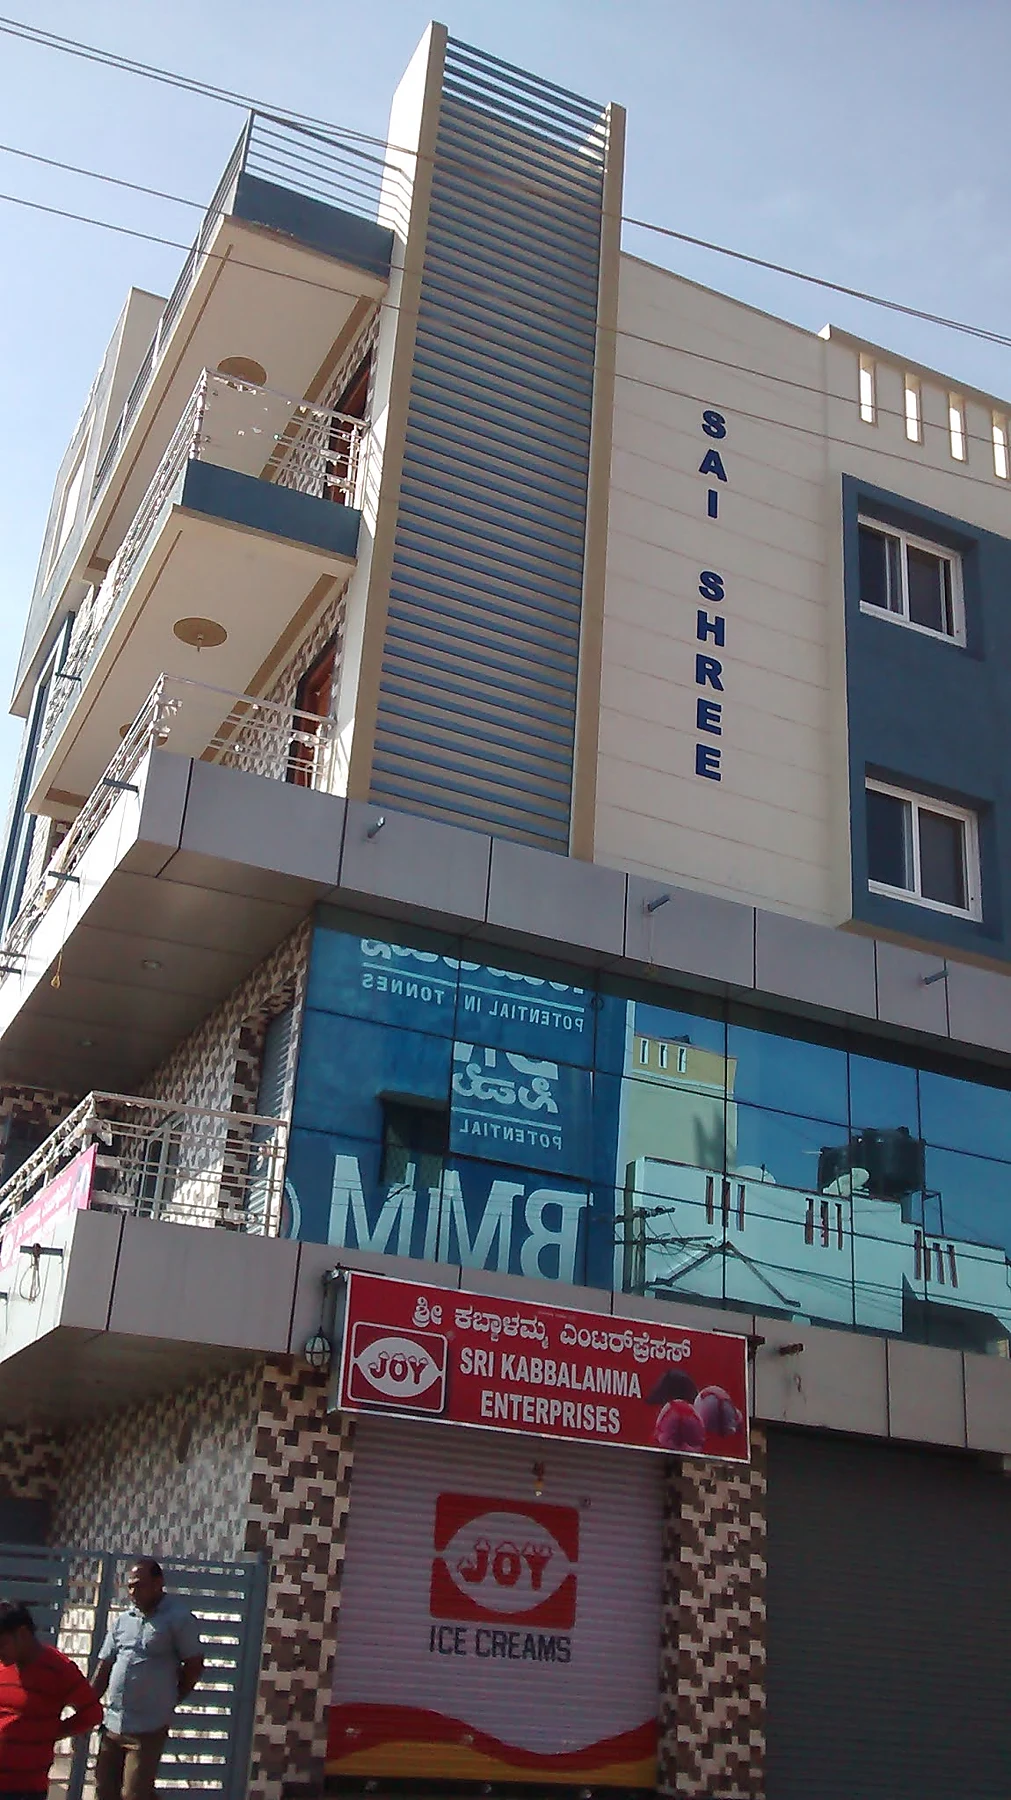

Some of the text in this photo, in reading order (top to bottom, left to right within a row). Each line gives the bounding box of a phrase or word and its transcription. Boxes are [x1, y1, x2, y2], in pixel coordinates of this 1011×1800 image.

[695, 410, 727, 783] SAI SHREE
[412, 1296, 443, 1327] ಶ್ರೀ
[367, 1351, 429, 1388] JOY
[460, 1346, 642, 1400] SRI KABBALAMMA
[481, 1389, 621, 1435] ENTERPRISES
[457, 1537, 553, 1591] JOY
[430, 1625, 571, 1663] ICE CREAMS
